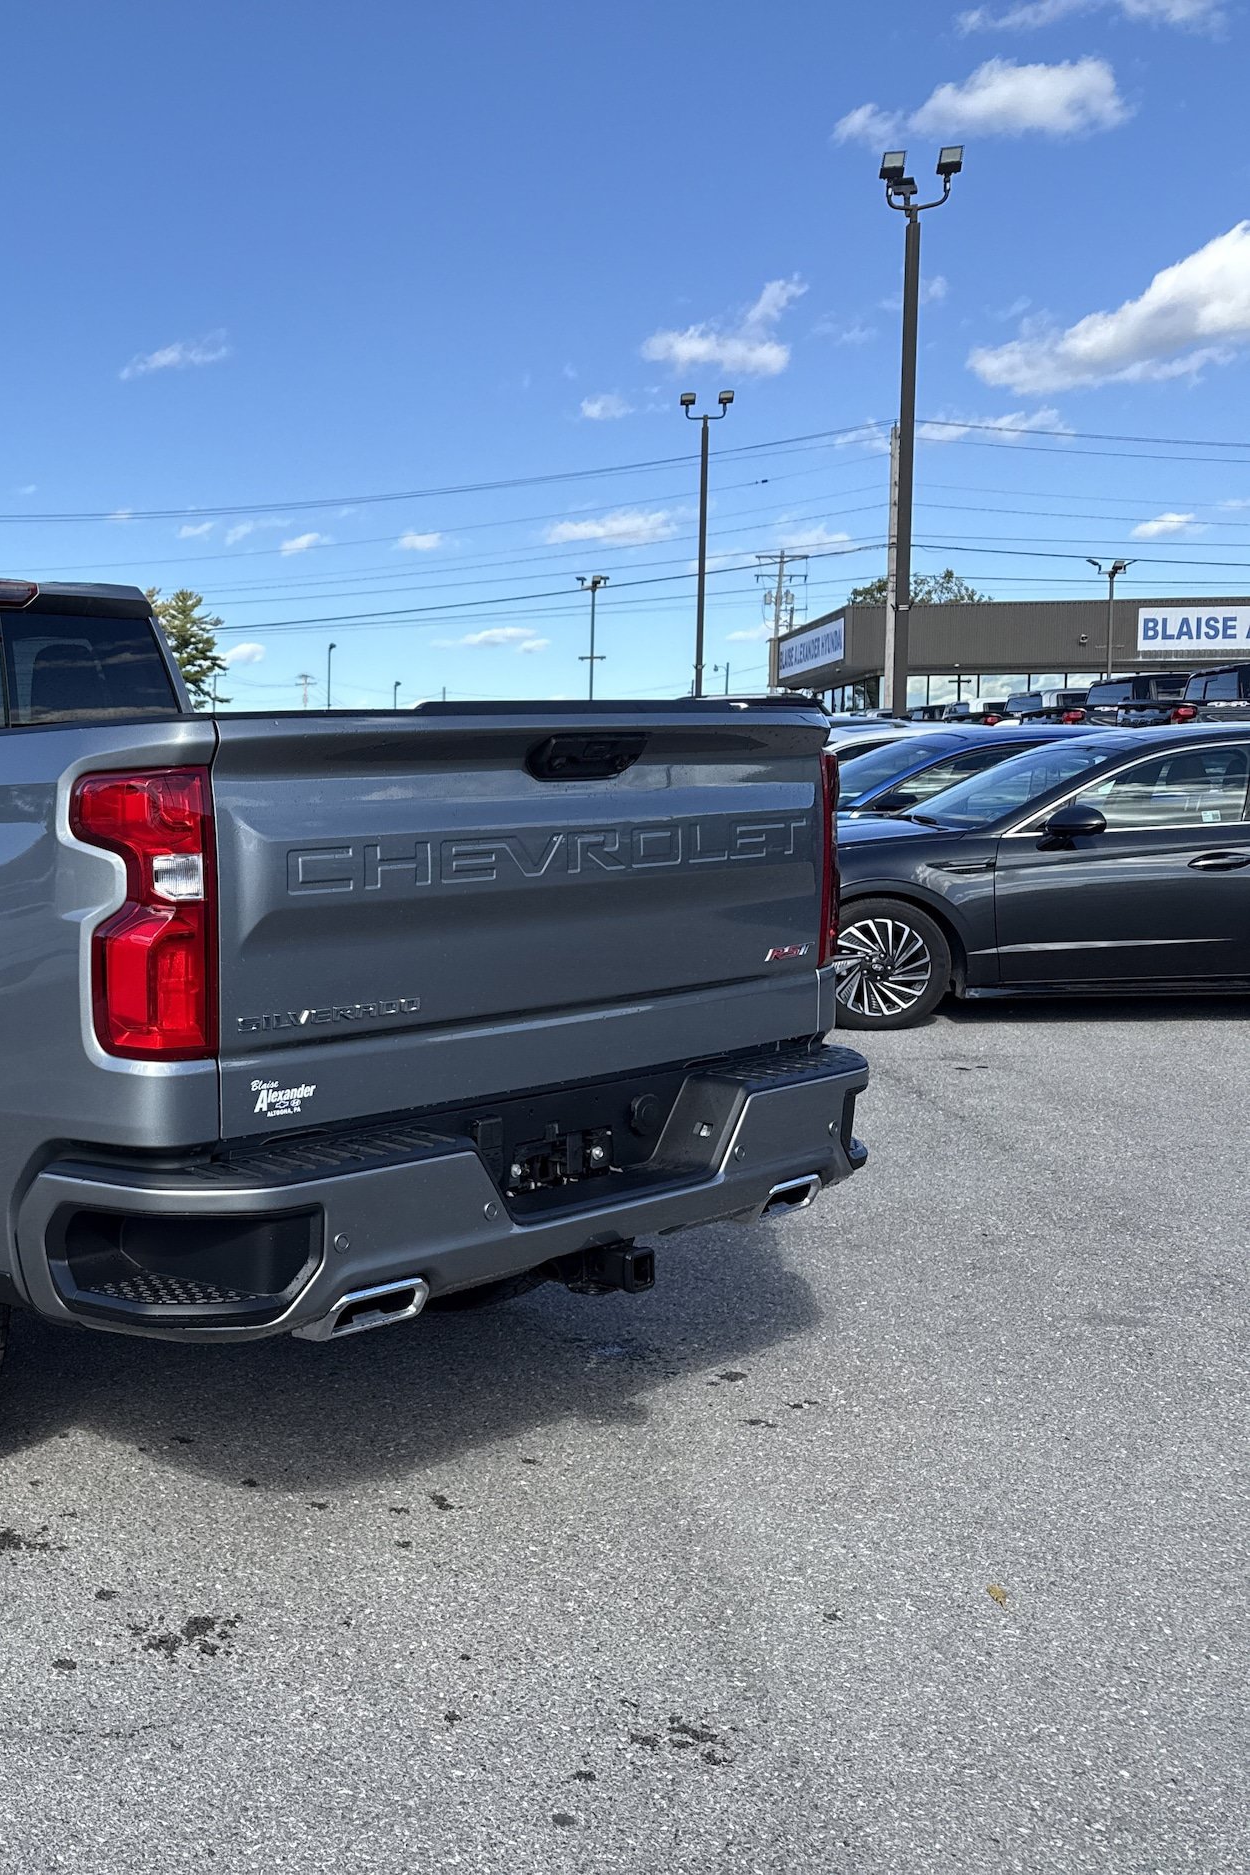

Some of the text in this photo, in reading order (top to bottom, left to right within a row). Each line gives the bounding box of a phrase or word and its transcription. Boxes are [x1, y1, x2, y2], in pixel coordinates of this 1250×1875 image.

[1142, 616, 1237, 640] BLAISE
[779, 629, 842, 670] BLAISE ALEXANDER HYUNDAI
[286, 817, 807, 896] CHEVROLET
[764, 941, 815, 962] RST
[237, 997, 421, 1033] SILVERADO
[250, 1079, 279, 1091] Blaise
[253, 1083, 317, 1113] Alexander
